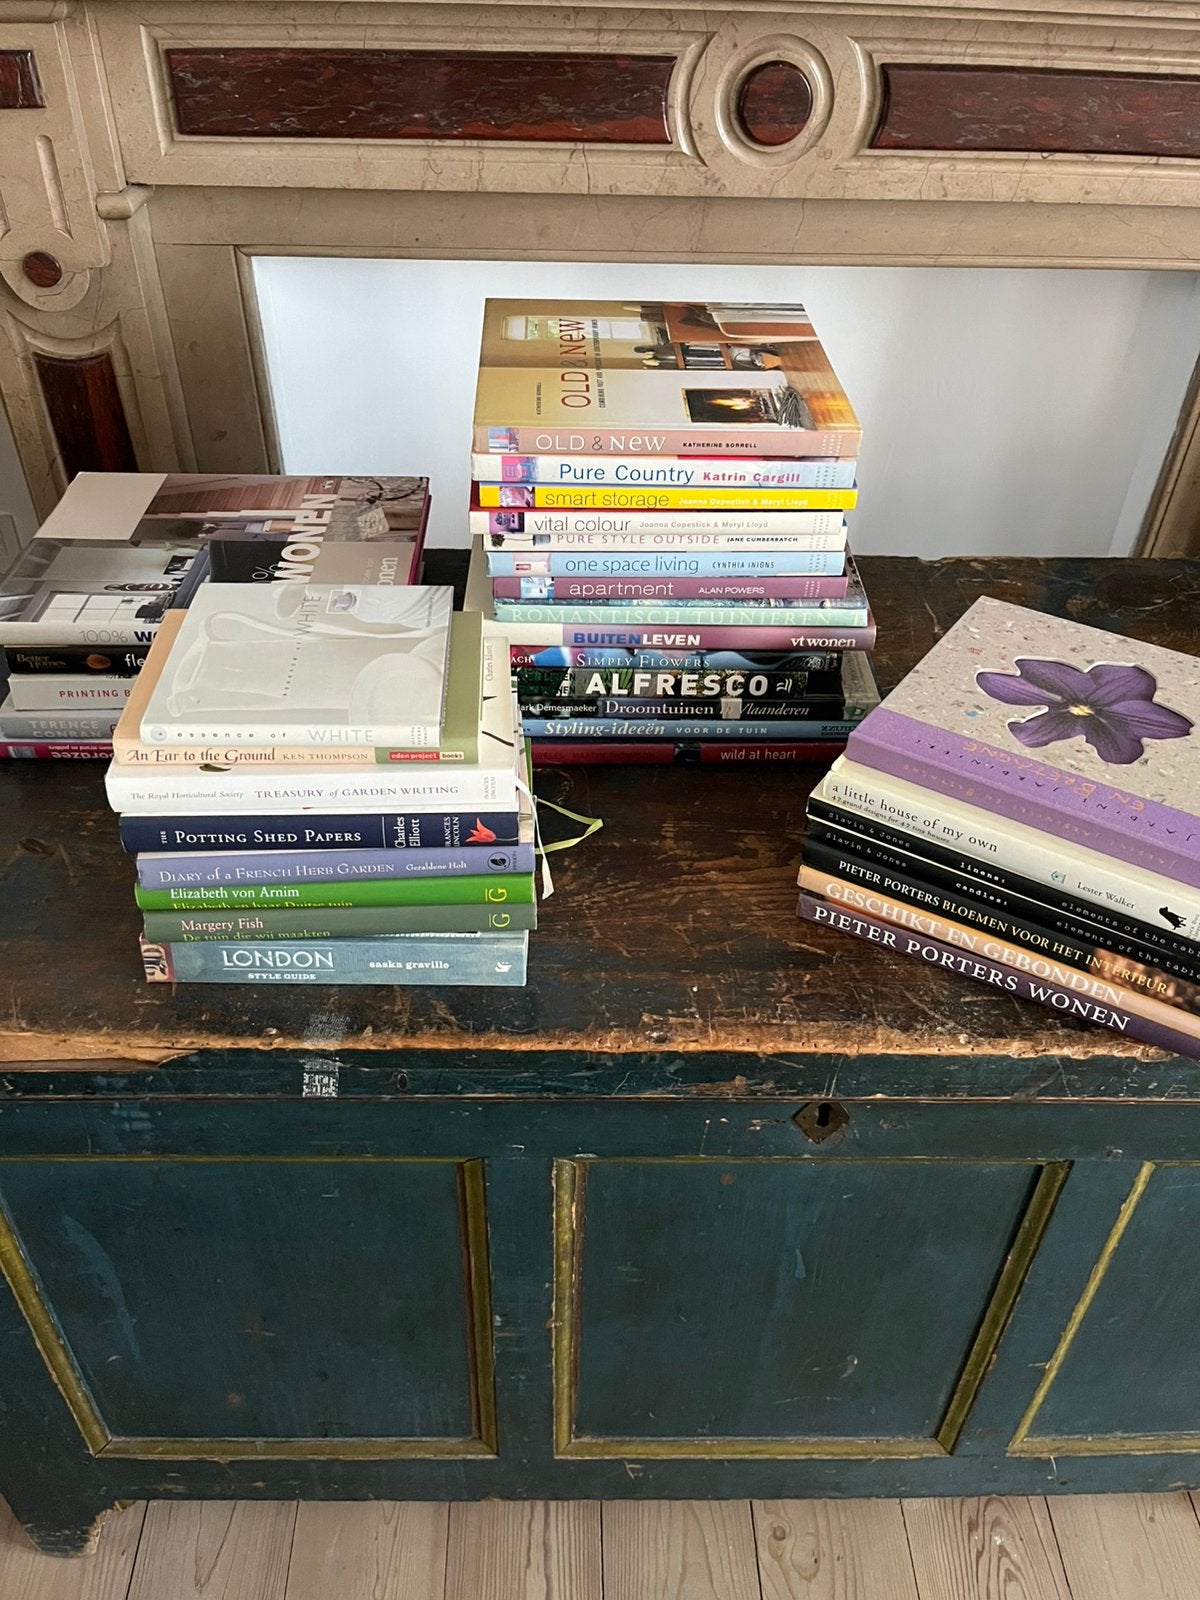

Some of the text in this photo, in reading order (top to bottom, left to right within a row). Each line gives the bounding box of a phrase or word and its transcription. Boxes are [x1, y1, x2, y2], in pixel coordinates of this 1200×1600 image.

[561, 371, 591, 408] OLD
[535, 434, 585, 451] OLD
[592, 435, 603, 451] &
[559, 463, 695, 485] Pure Country
[703, 471, 801, 484] Katrin Cargill
[545, 490, 670, 509] smart storage
[534, 516, 632, 532] vital colour
[671, 521, 711, 530] Copestick
[721, 521, 744, 530] Meryl
[746, 521, 769, 530] Lloyd
[270, 493, 338, 584] WONEN
[557, 534, 720, 544] PURE STYLE OUTSIDE
[565, 556, 699, 574] one space living
[712, 561, 745, 569] CYNTHIA
[569, 582, 675, 598] apartment
[724, 586, 765, 594] POWERS
[294, 595, 321, 636] WHITE
[512, 608, 832, 625] ROMANTISCH TUINIEREN
[79, 629, 129, 643] 100%
[573, 632, 701, 646] BUITENLEVEN
[16, 653, 49, 663] Better
[575, 653, 710, 668] SIMPLY FLOWERS
[585, 672, 769, 697] ALFRESCO
[59, 689, 119, 698] PRINTING
[538, 703, 597, 713] Demesmaeker
[605, 700, 714, 715] Droomtuinen
[28, 720, 99, 729] TERENCE
[544, 722, 665, 736] Styling-ideeën
[308, 729, 374, 743] WHITE
[128, 750, 148, 762] An
[150, 749, 179, 762] Ear
[183, 751, 195, 761] to
[200, 749, 219, 761] the
[224, 747, 275, 764] Ground
[308, 753, 369, 761] THOMPSON
[410, 752, 438, 761] project
[720, 749, 797, 760] wild at heart
[130, 790, 244, 801] The Royal Horticultural Society
[254, 786, 459, 799] TREASURY of GARDEN WRITING
[831, 794, 862, 812] 47 grand
[832, 785, 998, 852] a little house of my own
[174, 829, 247, 844] POTTING
[253, 829, 298, 843] SHED
[304, 829, 362, 843] PAPERS
[393, 816, 406, 849] Charles
[409, 818, 421, 847] Elliott
[828, 812, 864, 831] Slavin
[879, 830, 911, 848] Jones
[826, 832, 862, 851] Slavin
[876, 850, 907, 868] Jones
[159, 870, 202, 883] DIARY
[206, 867, 220, 881] of
[235, 867, 291, 880] FRENCH
[296, 865, 333, 877] HERB
[337, 862, 395, 875] GARDEN
[405, 861, 467, 872] Geraldene Holt
[170, 886, 300, 899] Elizabeth von Arnim
[1077, 881, 1135, 910] Lester Walker
[181, 917, 264, 932] Margery Fish
[839, 860, 1169, 995] PIETER PORTERS BLOEMEN VOOR HET INTERIEUR
[1061, 901, 1166, 944] elements of the
[183, 933, 200, 942] De
[233, 931, 251, 940] die
[255, 931, 274, 940] wij
[278, 929, 331, 938] maakten
[1056, 920, 1112, 946] elements
[1118, 943, 1133, 953] of
[1138, 950, 1160, 963] the
[825, 882, 1126, 1006] GESCHIKT EN GEBONDEN
[222, 949, 334, 968] LONDON
[369, 960, 450, 970] saska graville
[814, 905, 1131, 1031] PIETER PORTERS WONEN
[248, 972, 317, 980] STYLE GUIDE
